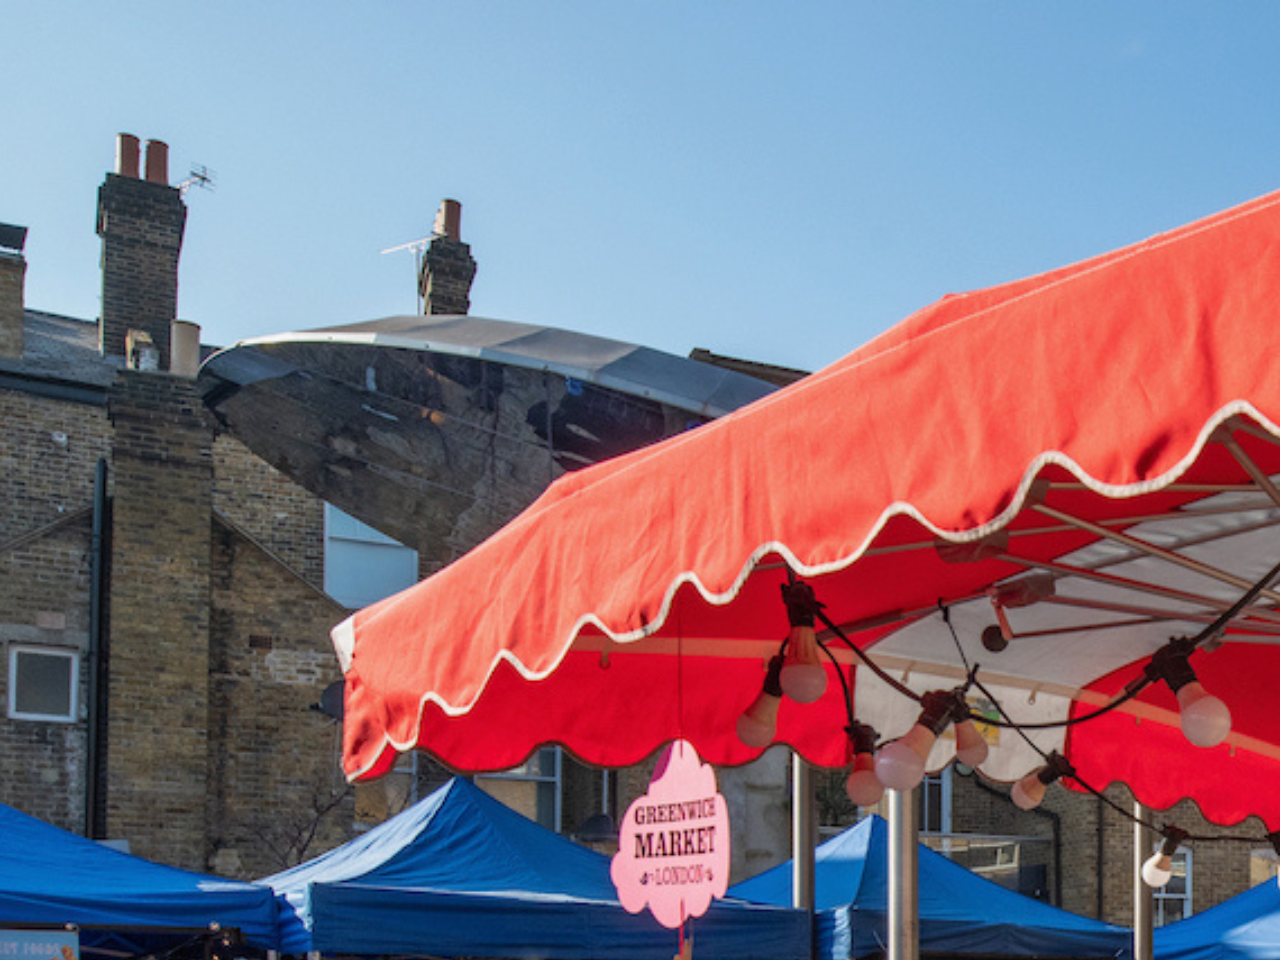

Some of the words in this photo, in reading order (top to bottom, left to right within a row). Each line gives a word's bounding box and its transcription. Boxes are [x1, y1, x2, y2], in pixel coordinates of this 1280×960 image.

[634, 797, 716, 825] GREENWICH
[634, 826, 716, 859] MARKET
[655, 864, 704, 885] LONDON
